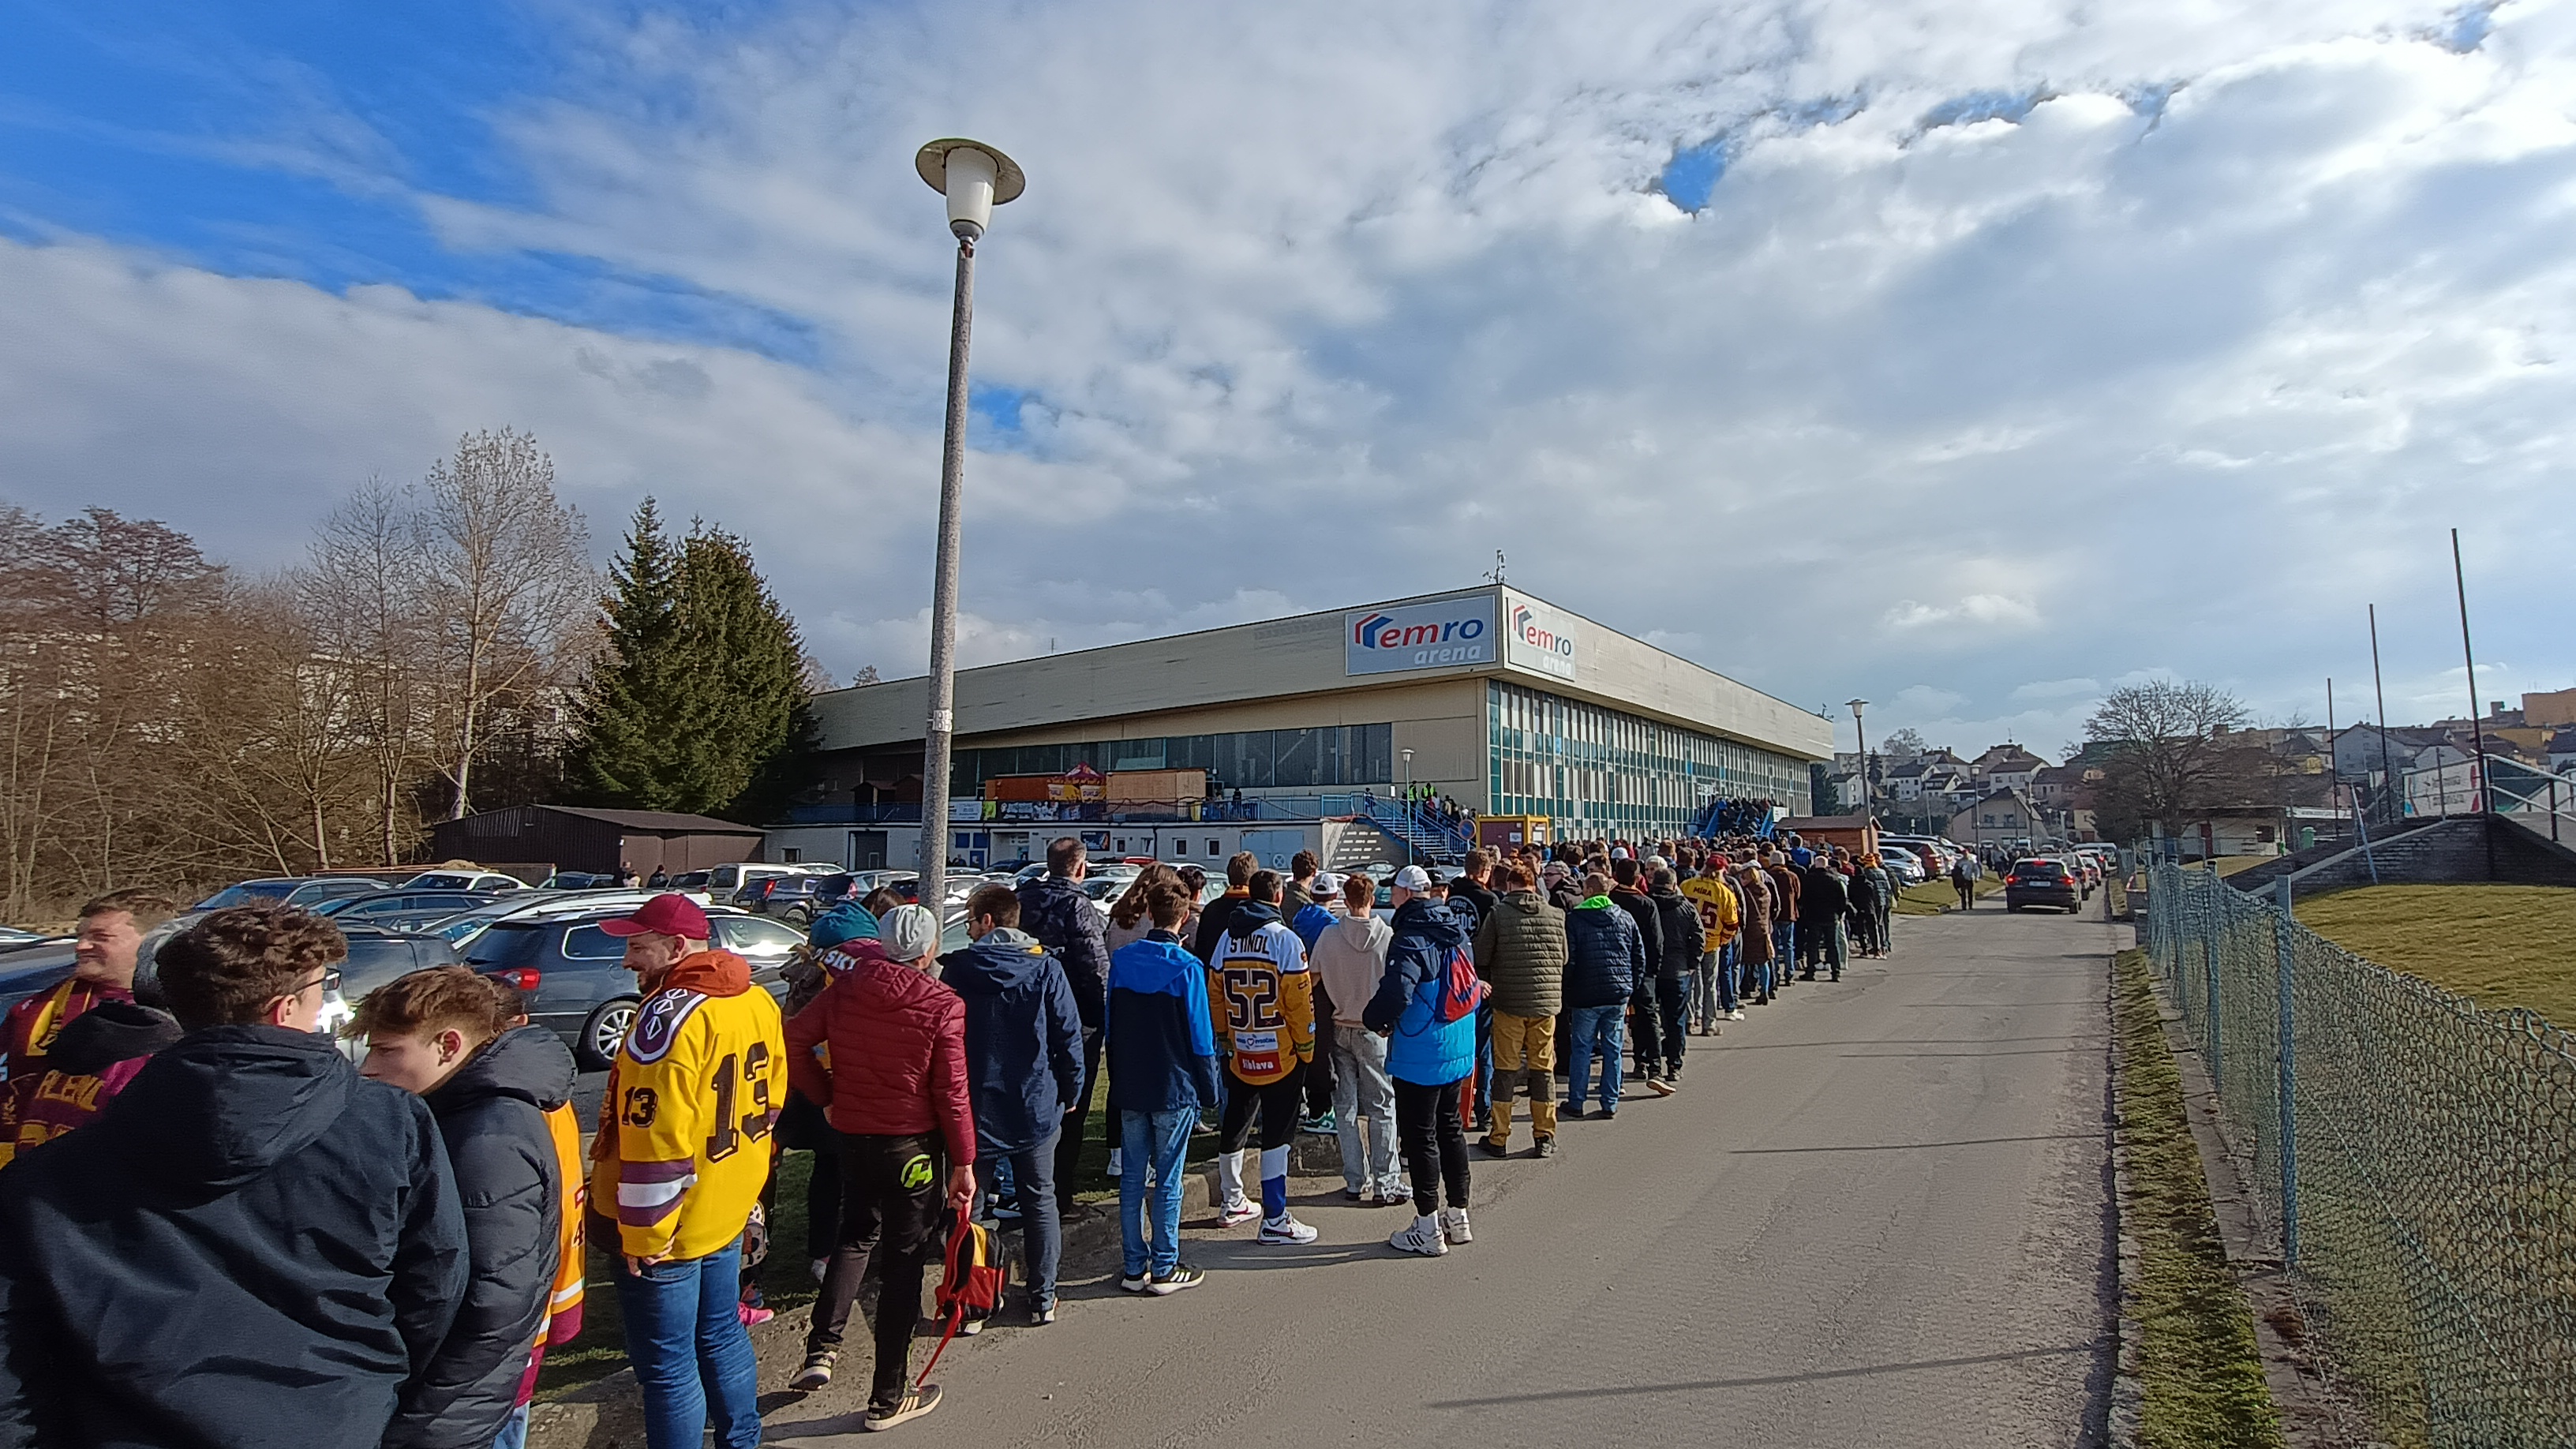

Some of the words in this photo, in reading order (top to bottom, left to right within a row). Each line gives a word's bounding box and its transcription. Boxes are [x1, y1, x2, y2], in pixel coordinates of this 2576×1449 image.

[1413, 645, 1481, 665] arena
[1542, 654, 1572, 676] arena
[1693, 886, 1713, 897] MÍRA
[1223, 968, 1286, 1031] 52
[622, 1086, 659, 1129] 13
[706, 1040, 776, 1165] 13
